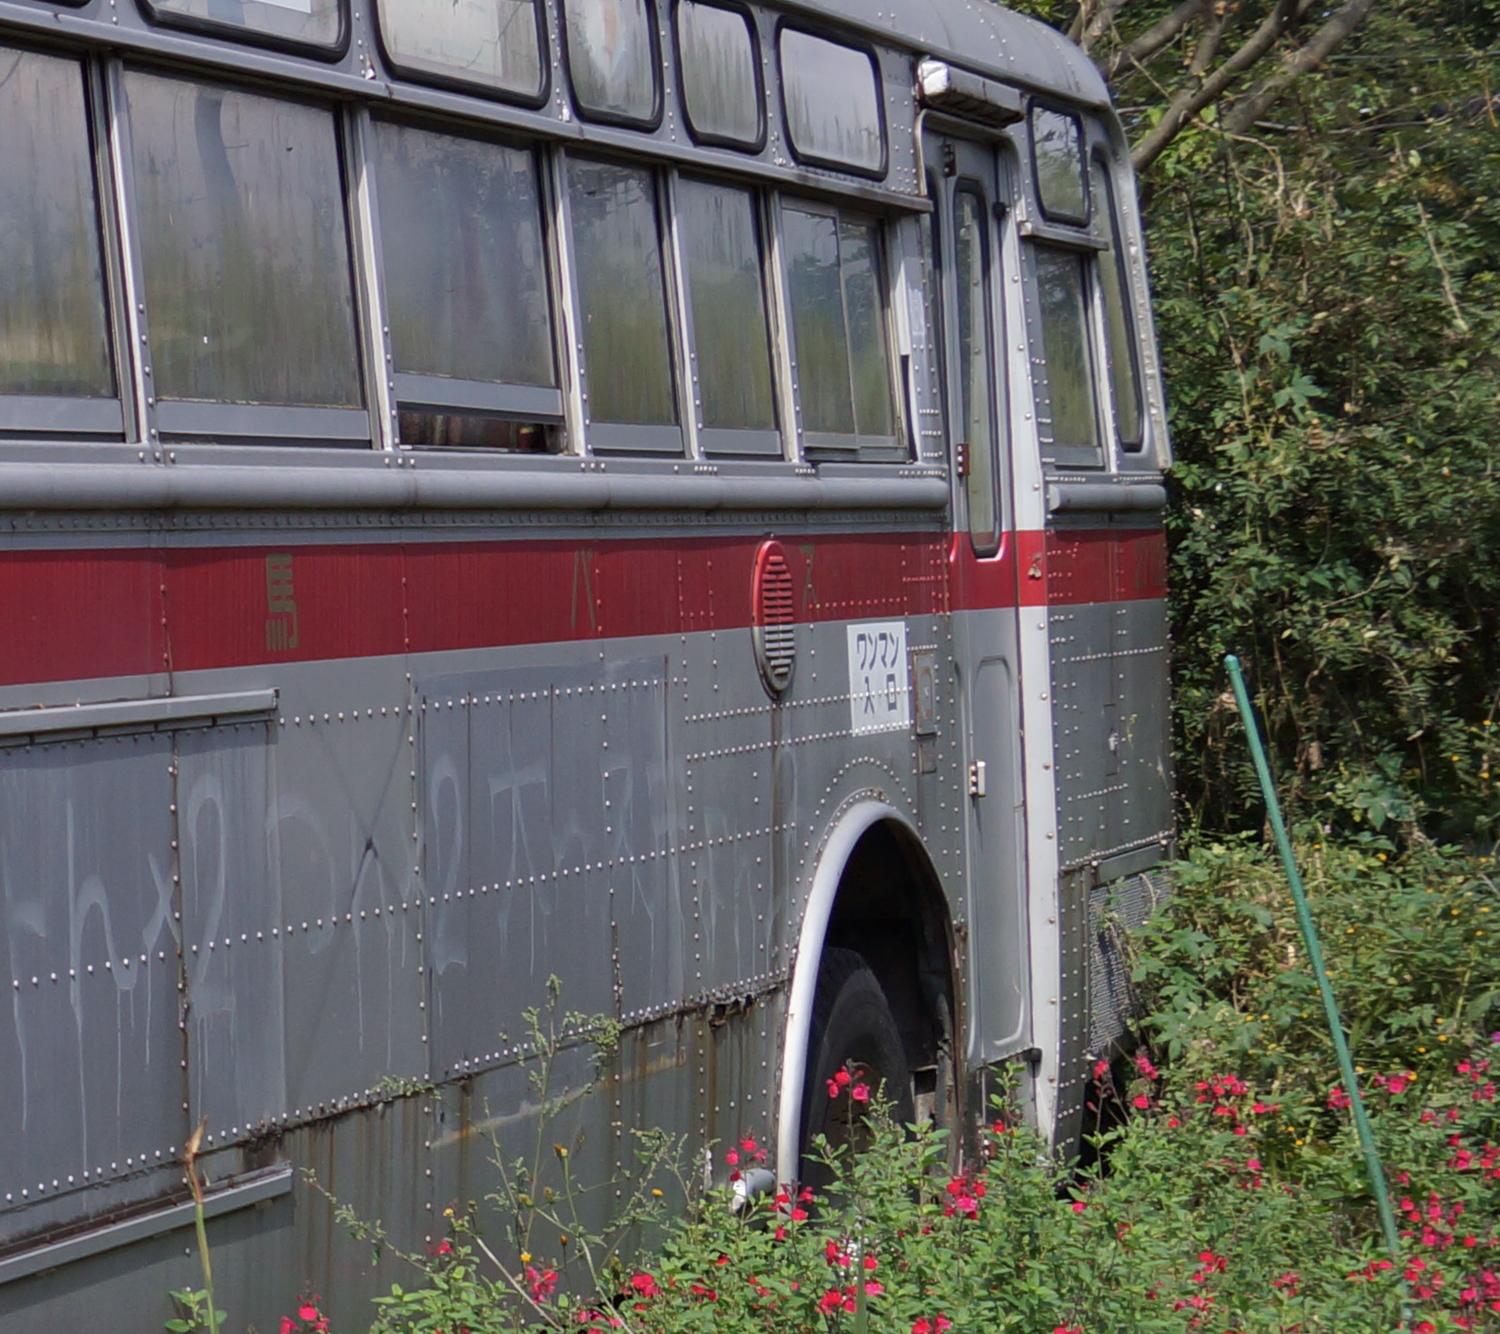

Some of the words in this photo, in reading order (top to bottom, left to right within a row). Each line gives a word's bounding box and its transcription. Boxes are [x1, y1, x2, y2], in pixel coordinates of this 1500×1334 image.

[856, 632, 900, 671] ワンマン
[863, 673, 898, 715] 入口
